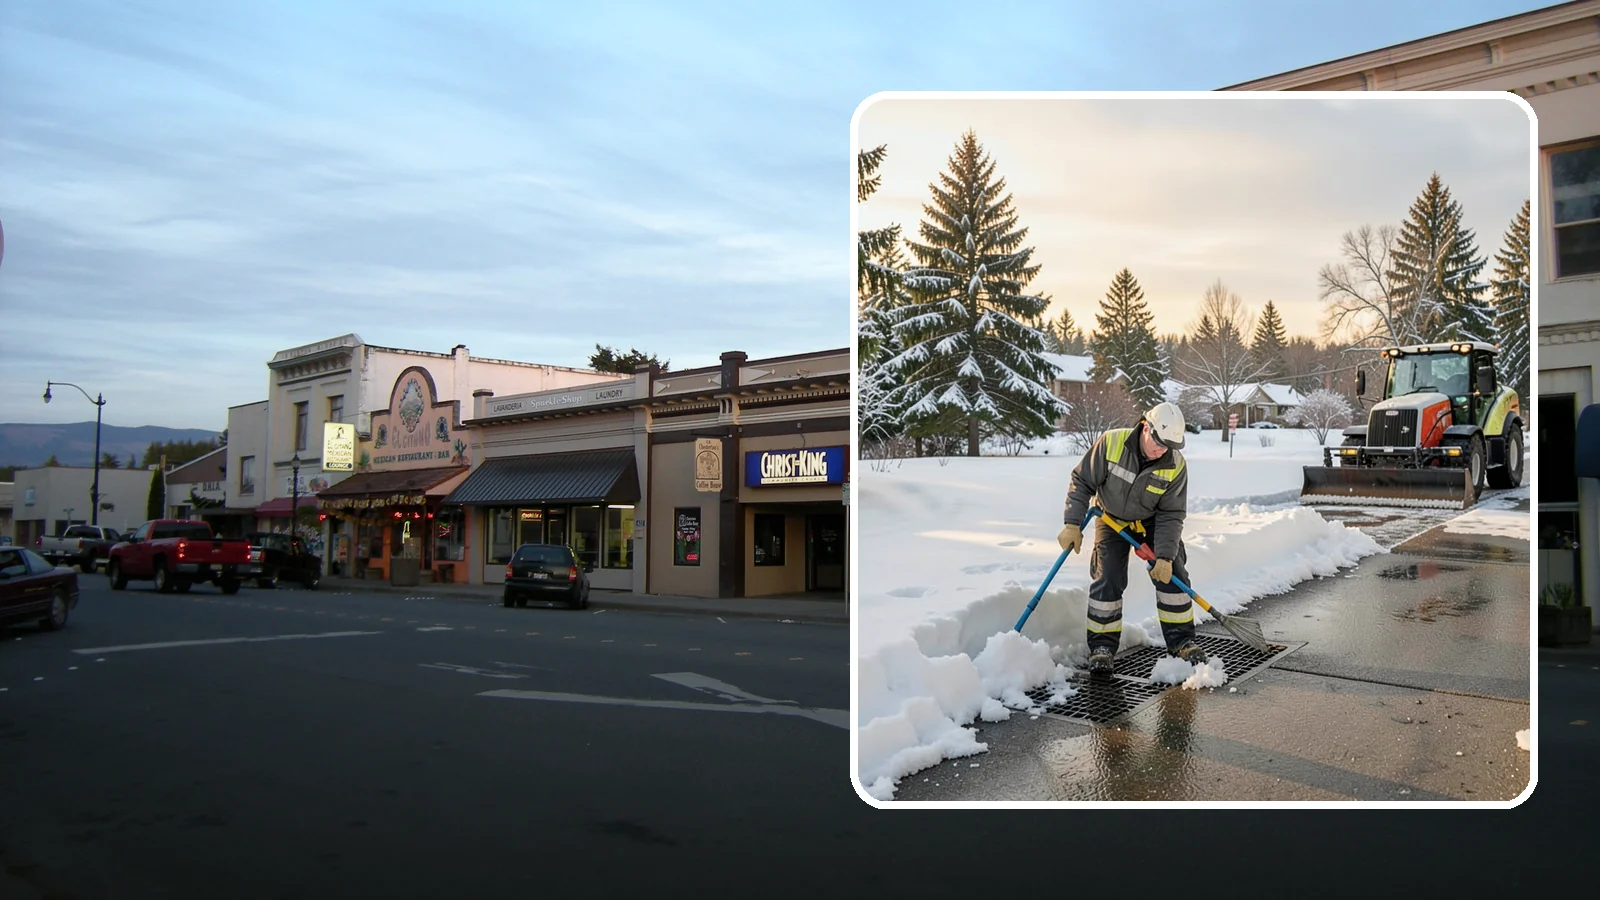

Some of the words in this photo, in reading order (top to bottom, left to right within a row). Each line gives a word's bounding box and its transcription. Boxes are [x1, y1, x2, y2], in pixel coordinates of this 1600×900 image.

[493, 402, 522, 413] LAVANDERIA
[531, 399, 560, 409] Sparkle
[562, 395, 582, 405] Shop
[596, 389, 623, 400] LAUNDRY
[392, 425, 401, 449] EL
[373, 455, 396, 464] MEXICAN
[397, 451, 433, 462] RESTAURANT
[438, 450, 450, 459] BAR
[761, 452, 797, 478] CHRIST
[799, 450, 827, 476] KING
